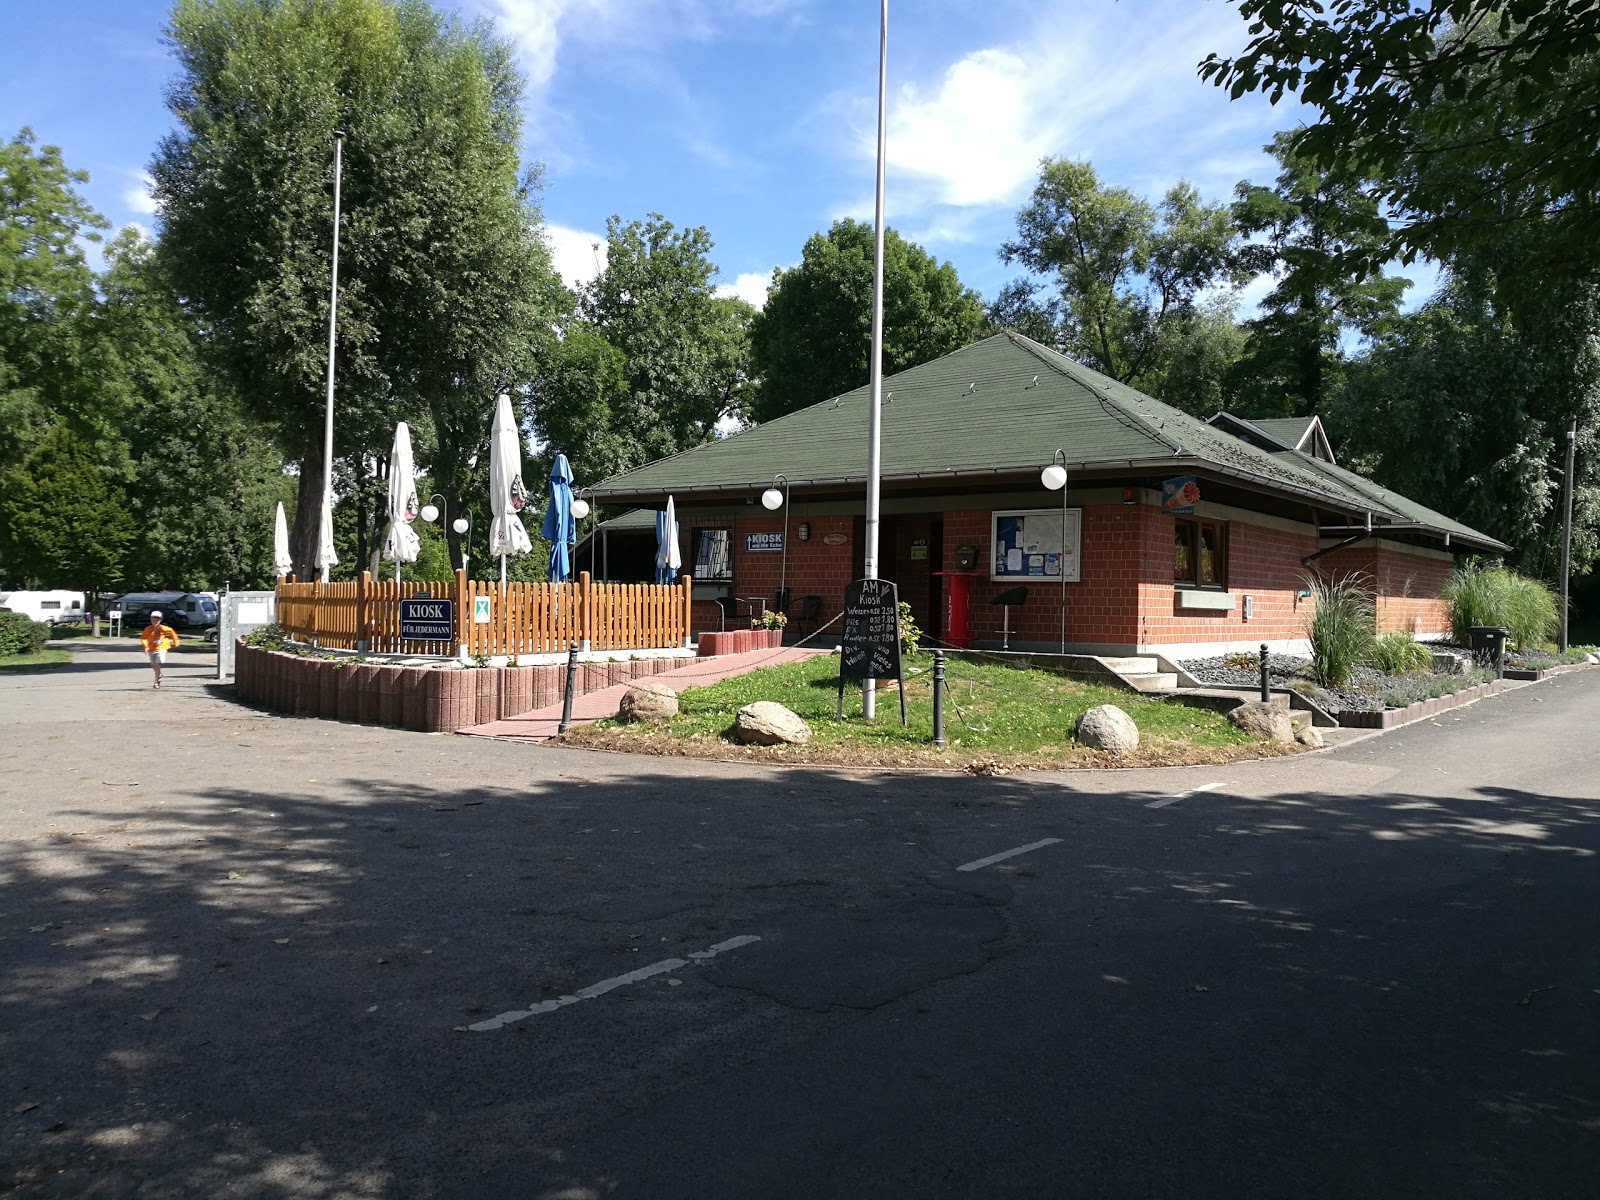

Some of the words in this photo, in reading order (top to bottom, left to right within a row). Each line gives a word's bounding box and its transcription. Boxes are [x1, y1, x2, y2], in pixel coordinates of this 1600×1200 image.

[752, 534, 782, 543] KIOSK
[862, 581, 878, 593] AM
[859, 594, 880, 604] Kiosk
[409, 605, 443, 618] KIOSK
[881, 606, 894, 615] 2.50
[846, 618, 860, 626] Pils
[403, 624, 414, 633] FÜR
[415, 626, 450, 634] JEDERMANN
